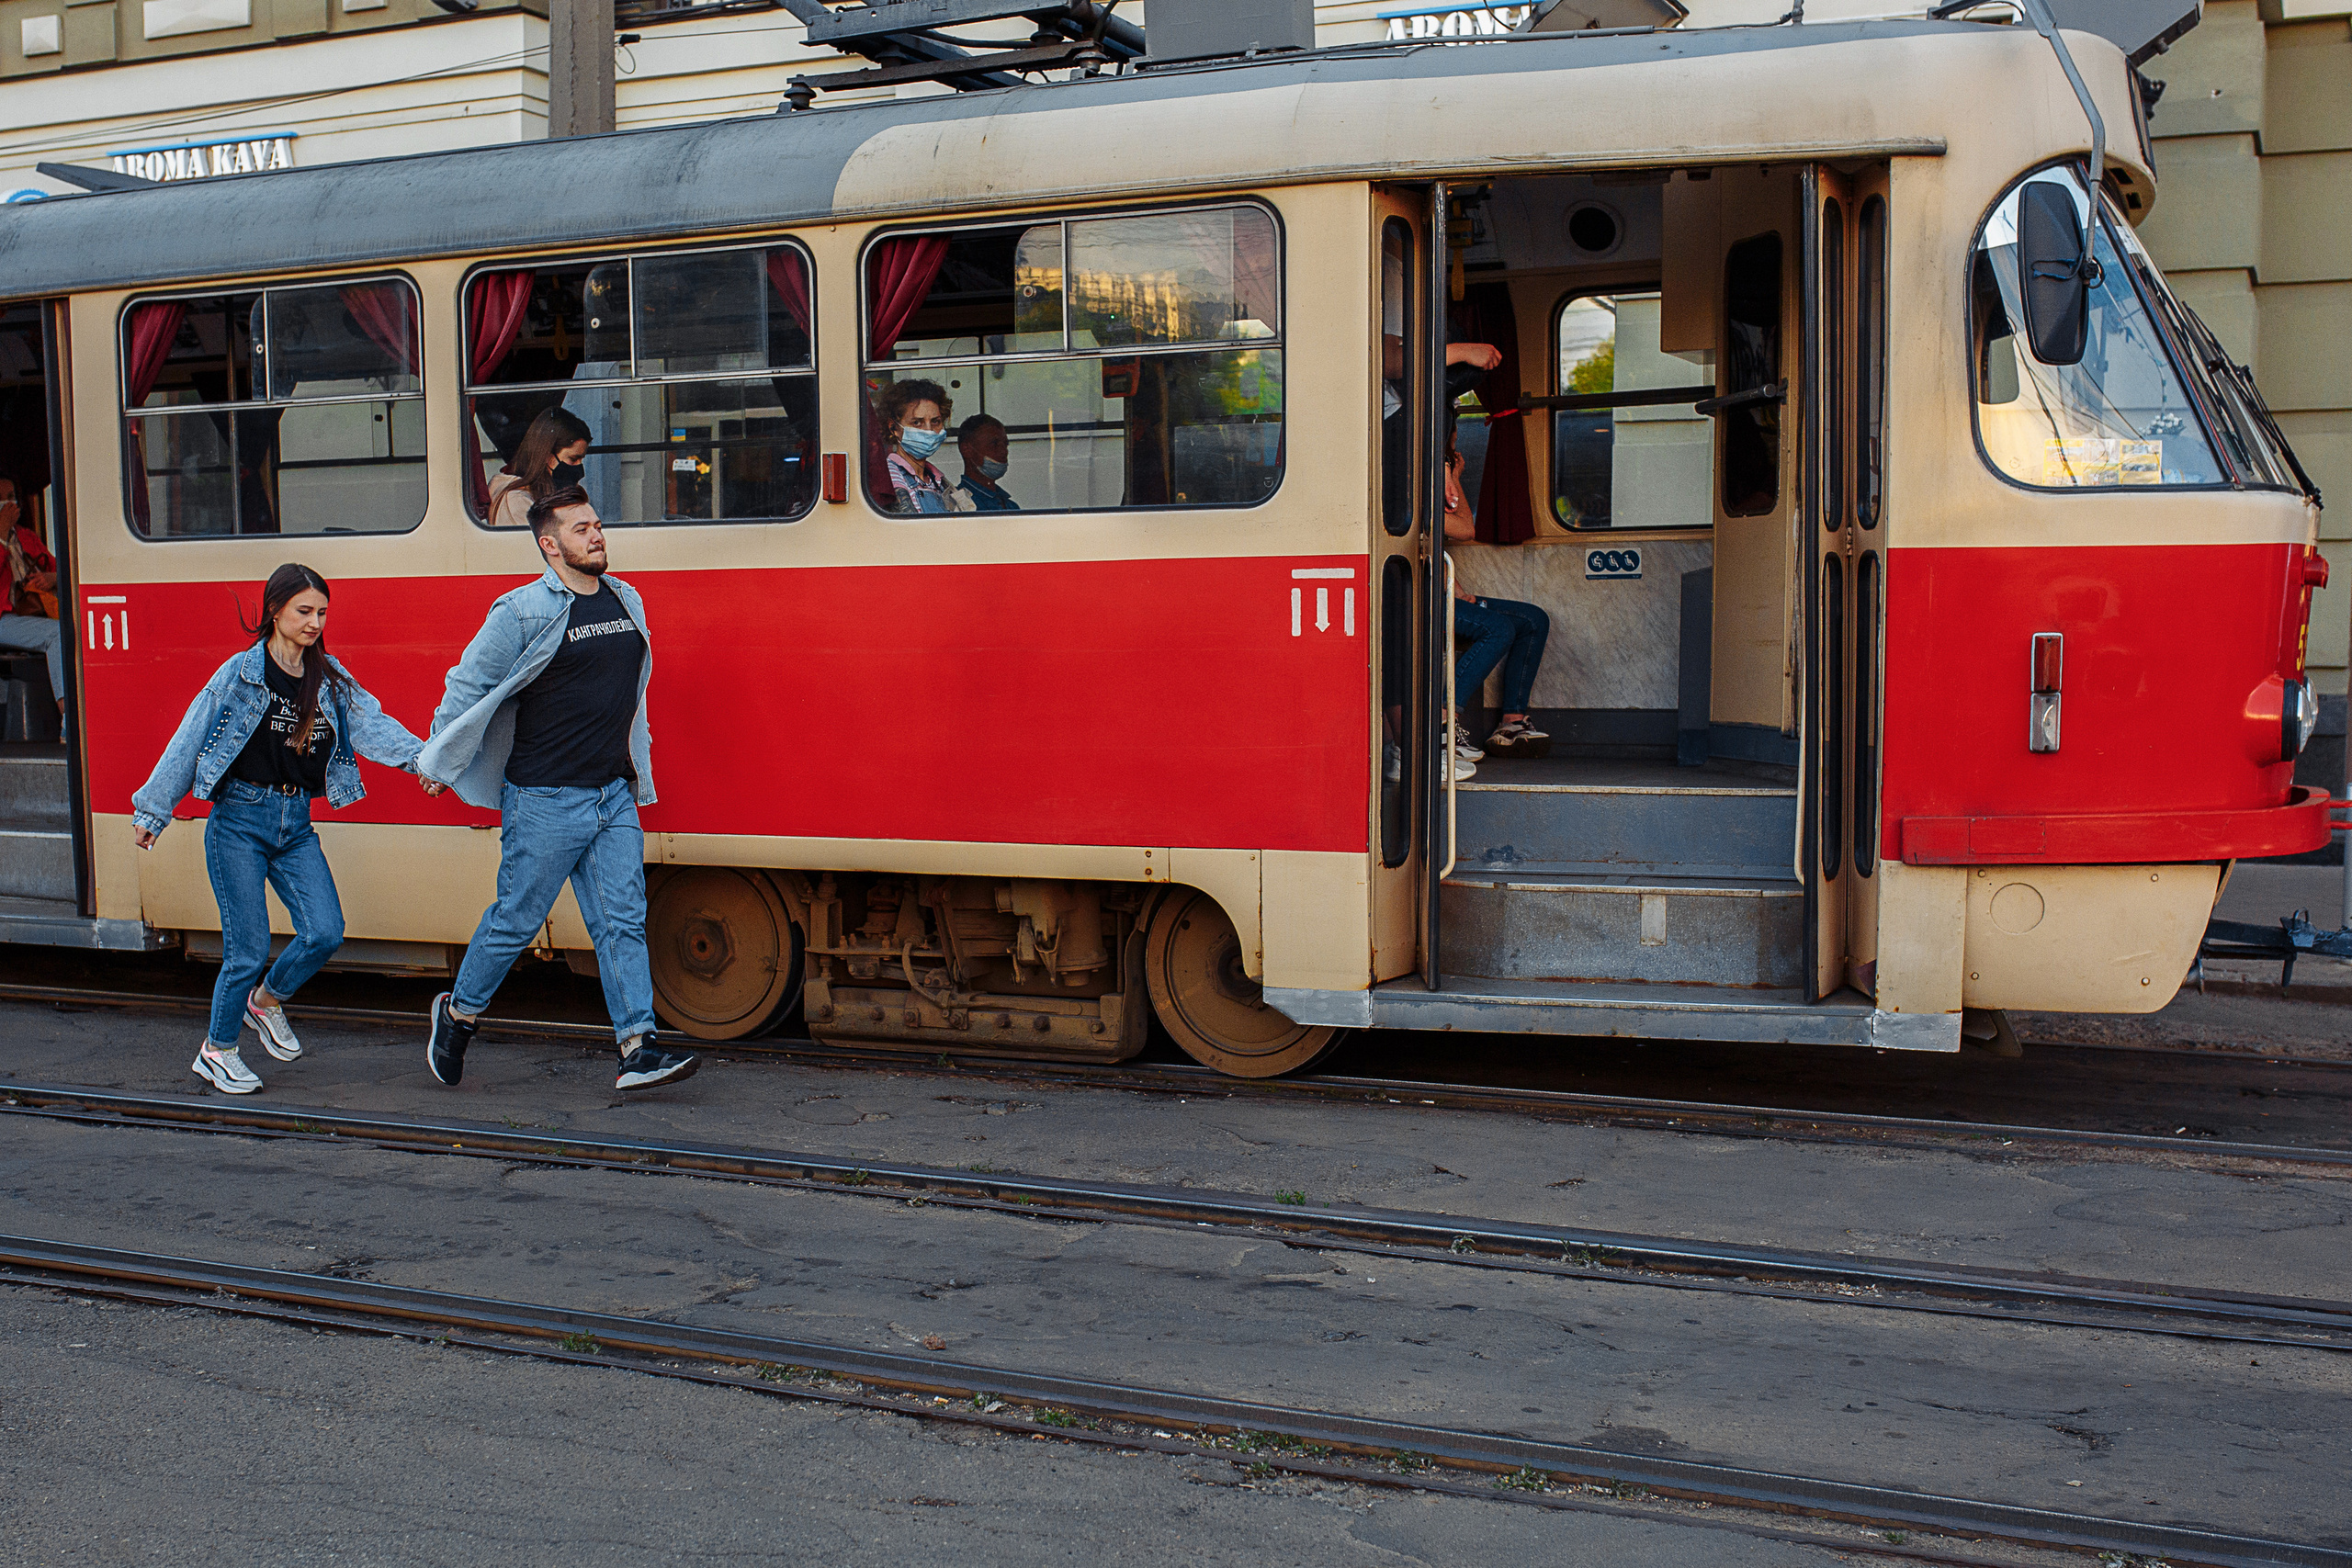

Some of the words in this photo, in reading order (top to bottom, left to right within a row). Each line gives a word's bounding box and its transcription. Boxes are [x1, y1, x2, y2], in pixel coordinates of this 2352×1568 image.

[112, 147, 208, 182] AROMA
[211, 139, 292, 175] KAVA
[567, 618, 637, 642] КАНГРАЧЮЛЕЙШ
[270, 720, 286, 732] BE
